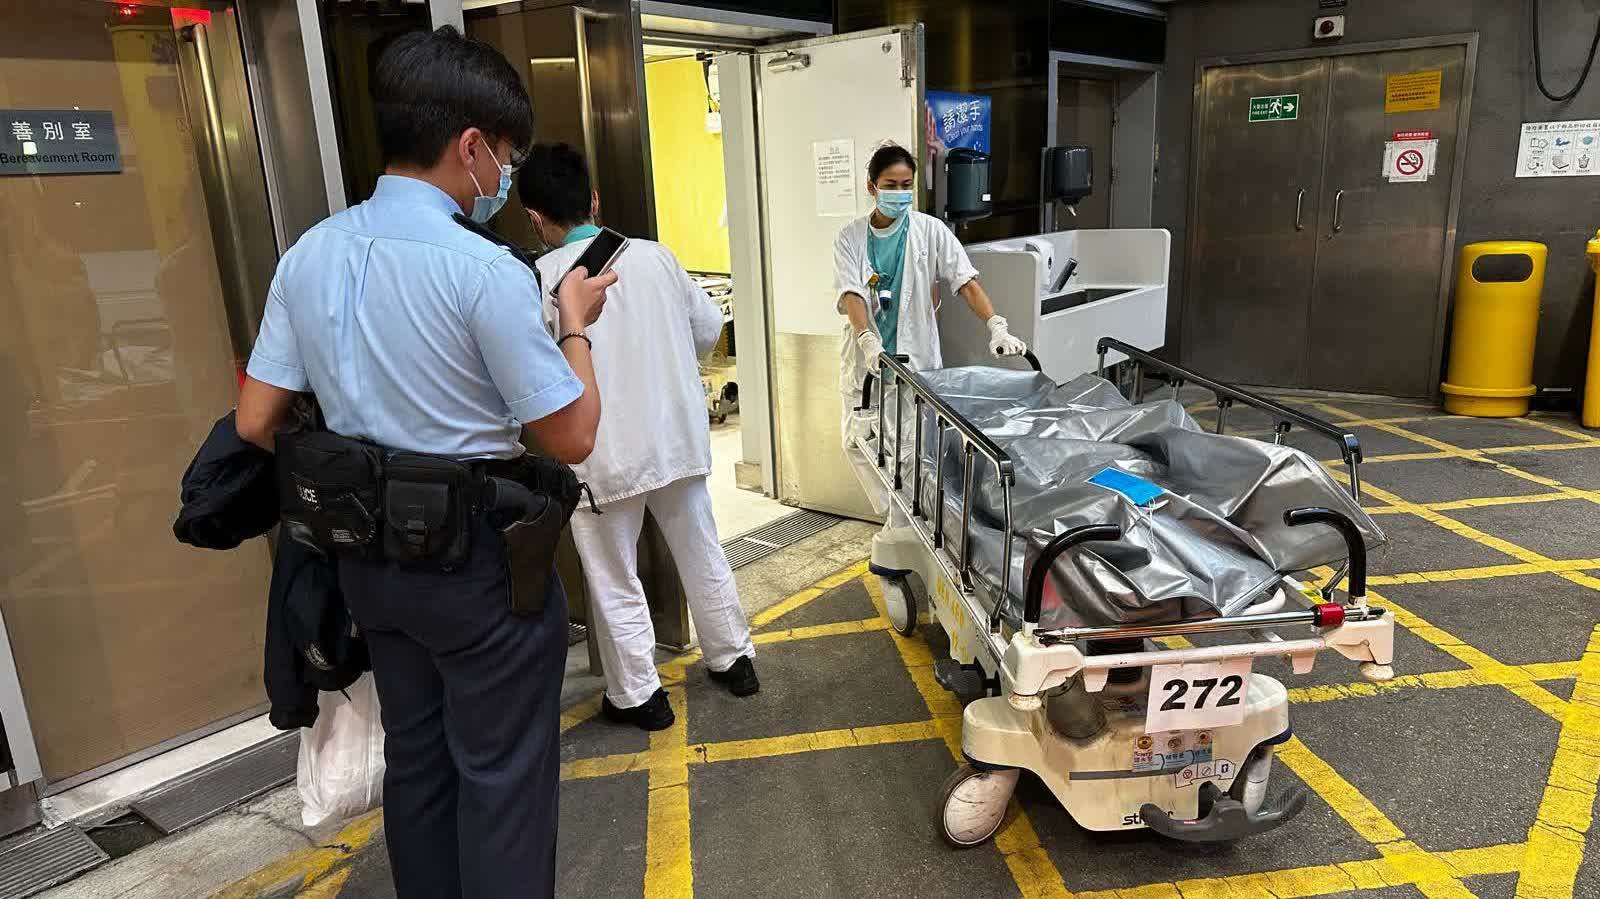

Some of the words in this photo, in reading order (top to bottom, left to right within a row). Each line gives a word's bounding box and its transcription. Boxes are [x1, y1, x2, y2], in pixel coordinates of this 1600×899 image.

[943, 100, 981, 133] 請潔手
[11, 121, 94, 140] 善別室
[0, 152, 80, 163] Bereavement
[81, 151, 115, 162] Room
[1160, 675, 1242, 711] 272
